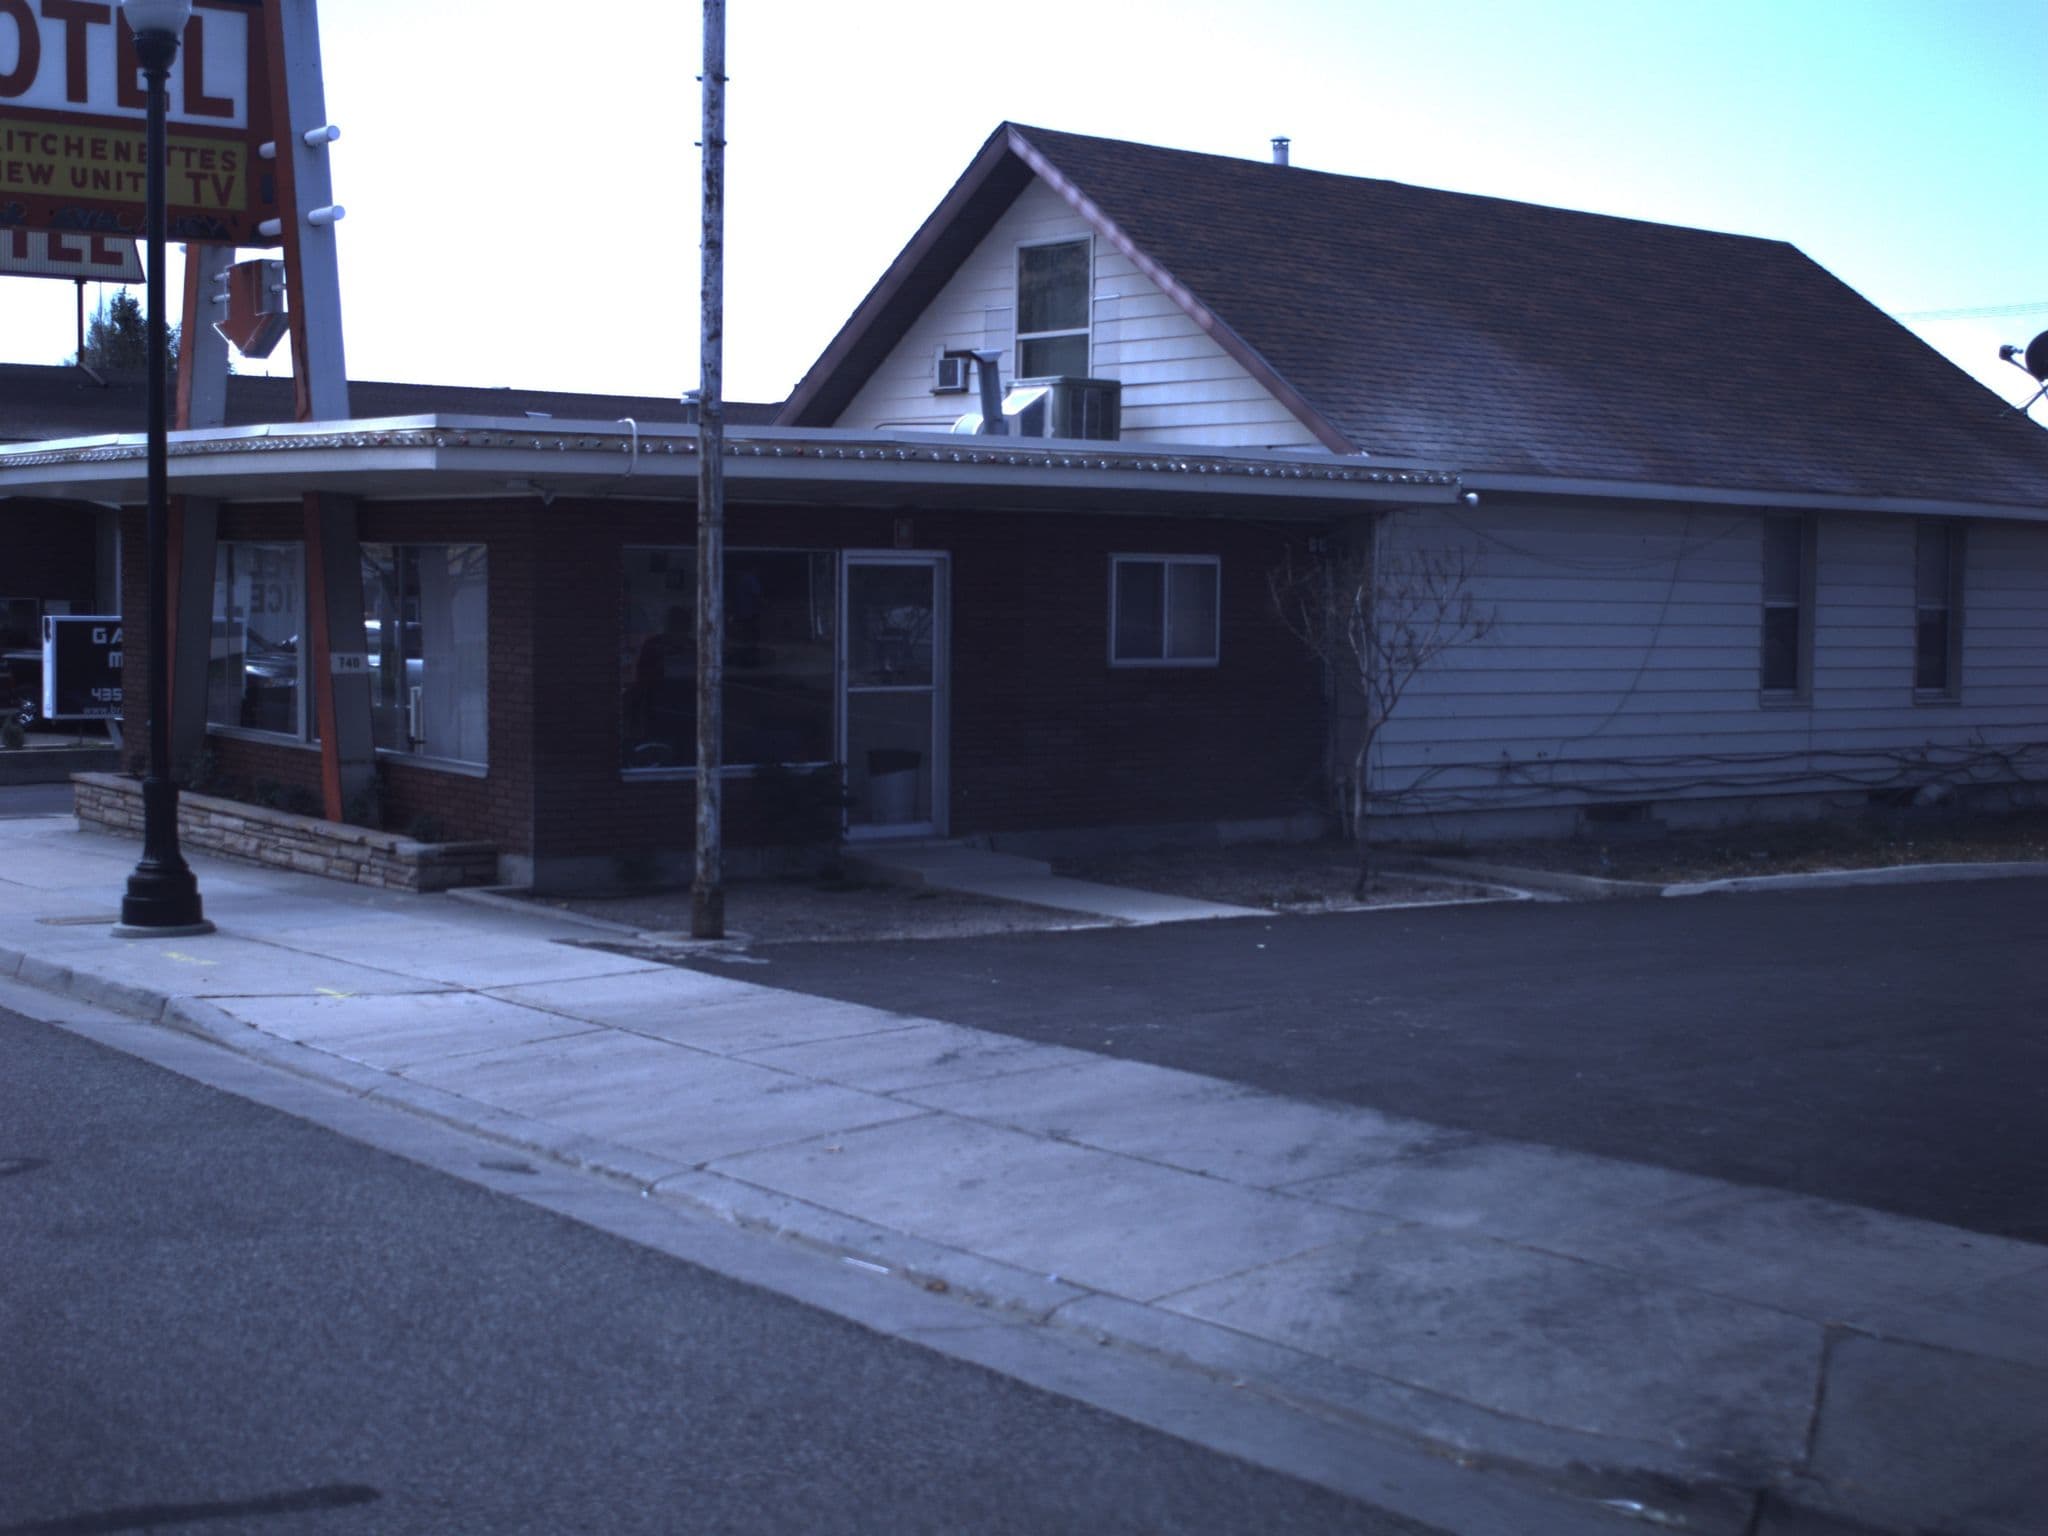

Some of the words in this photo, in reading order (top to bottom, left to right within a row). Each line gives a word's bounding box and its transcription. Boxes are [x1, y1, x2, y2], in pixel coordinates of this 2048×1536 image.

[0, 129, 237, 171] ITCHENETTES
[0, 161, 55, 185] EW
[186, 172, 235, 206] TV
[91, 687, 123, 703] 435
